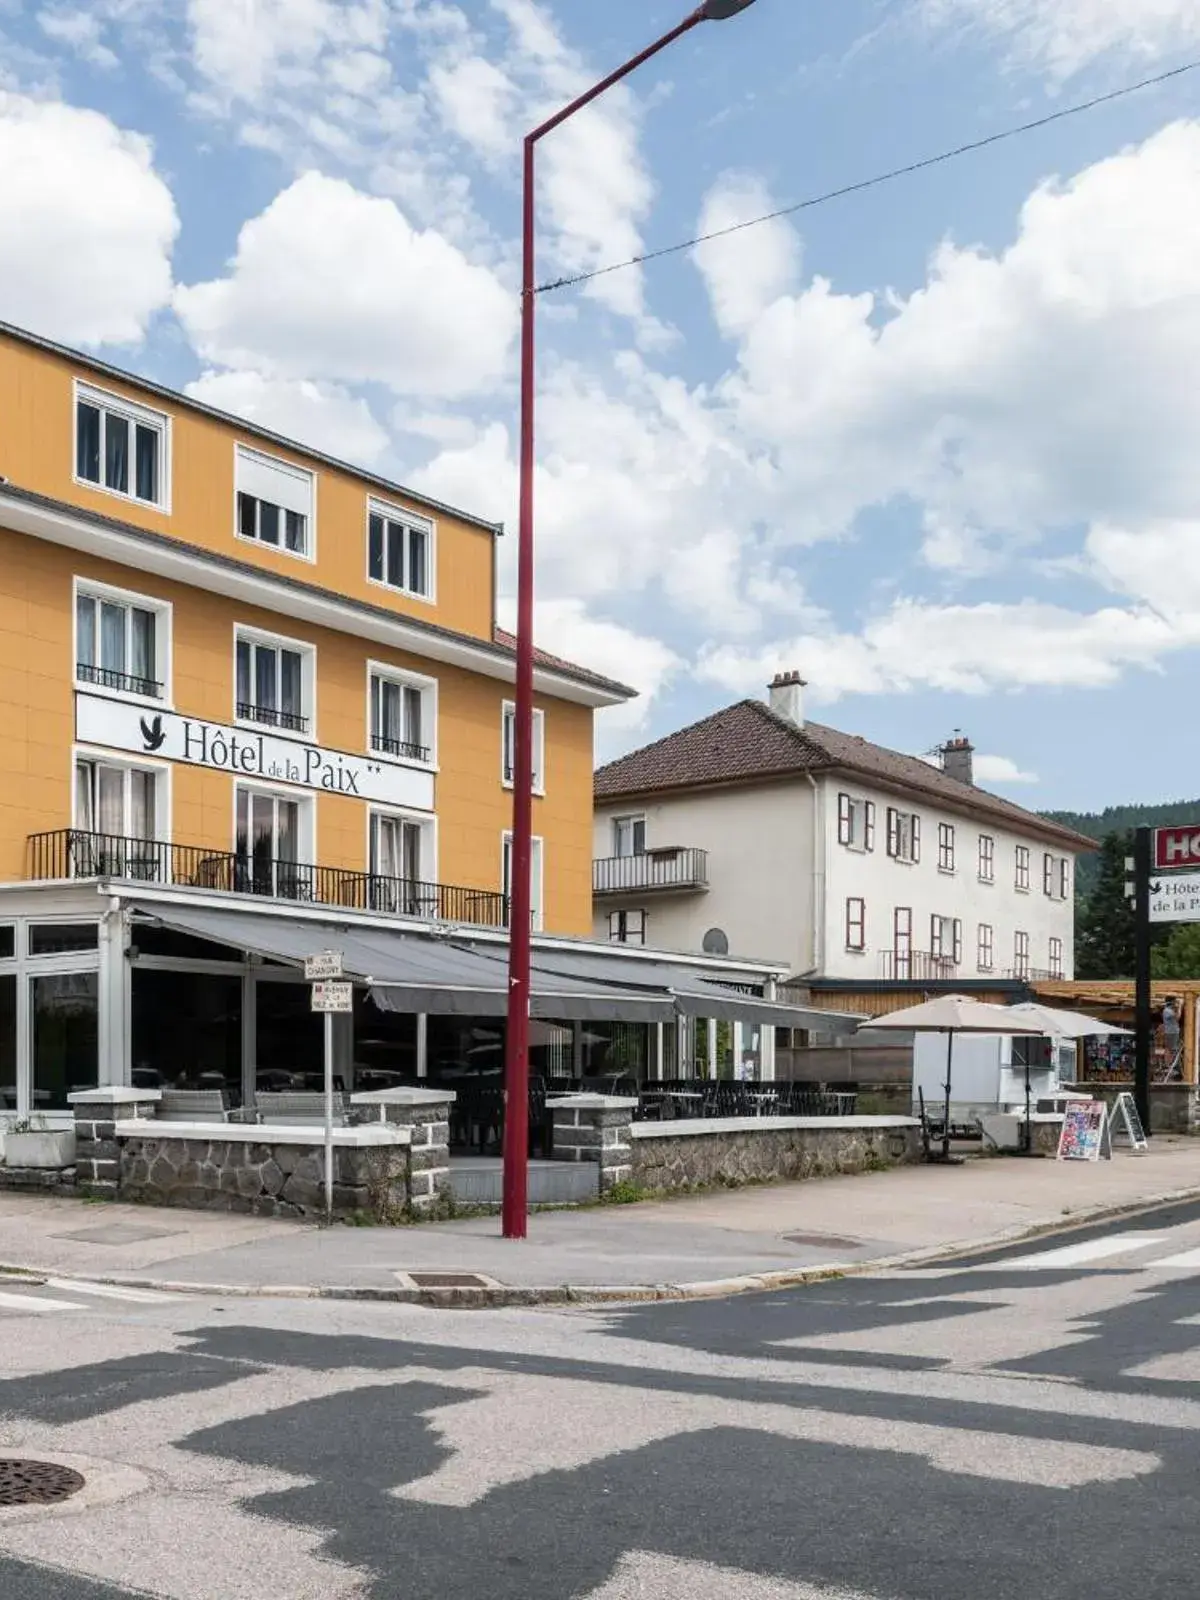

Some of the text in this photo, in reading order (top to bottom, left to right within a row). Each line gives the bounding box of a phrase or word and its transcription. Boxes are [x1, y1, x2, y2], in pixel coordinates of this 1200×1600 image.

[182, 720, 360, 794] Hôtel de la Paix
[1152, 900, 1171, 912] de
[1174, 899, 1185, 911] la
